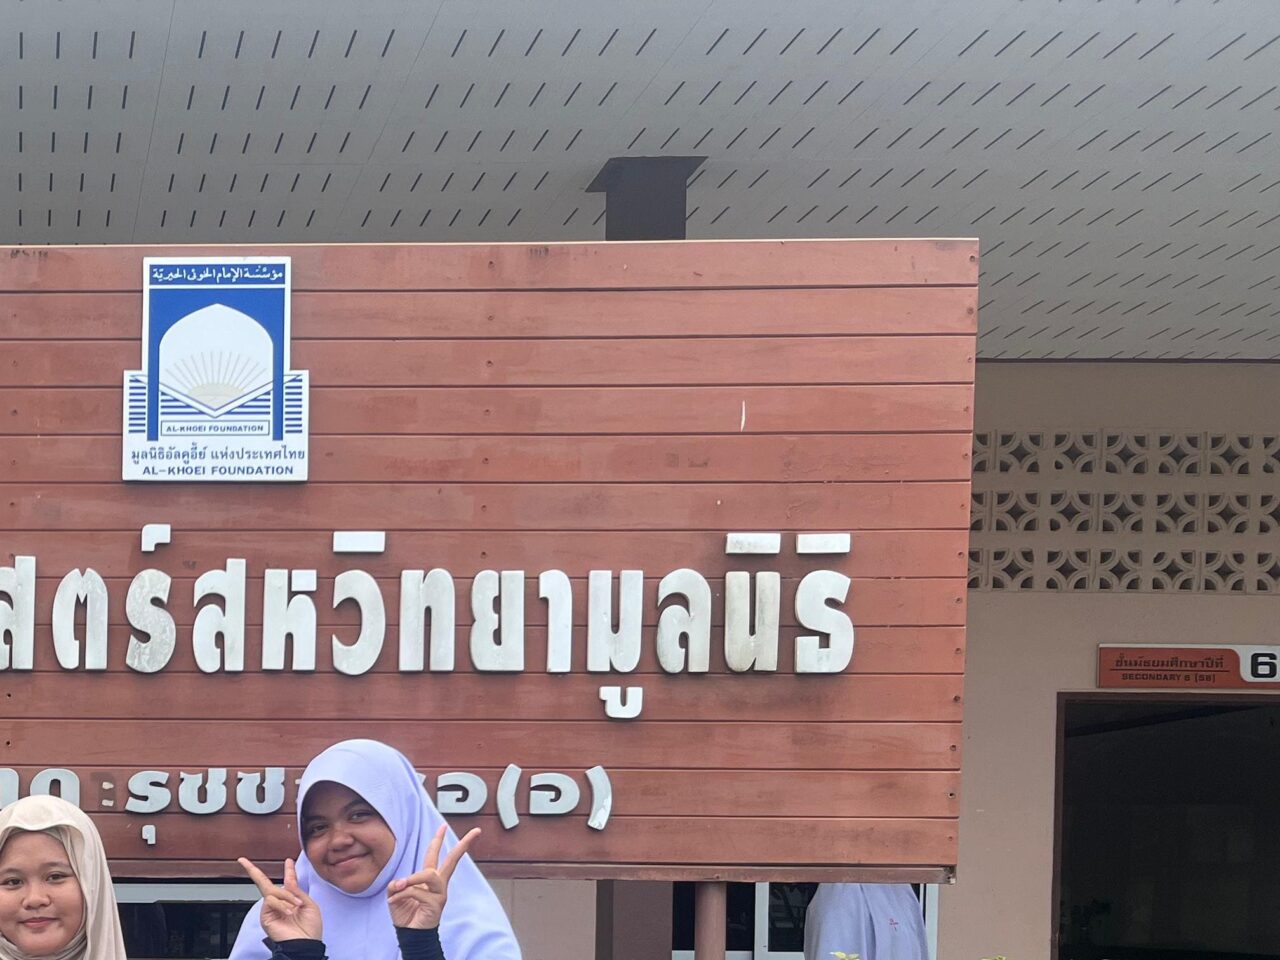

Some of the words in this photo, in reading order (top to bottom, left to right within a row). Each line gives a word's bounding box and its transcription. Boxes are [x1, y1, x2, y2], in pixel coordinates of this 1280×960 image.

[211, 444, 305, 460] แห่งประเทศไทย
[211, 465, 294, 475] FOUNDATION
[1251, 652, 1277, 678] 6
[1121, 673, 1181, 681] SECONDARY
